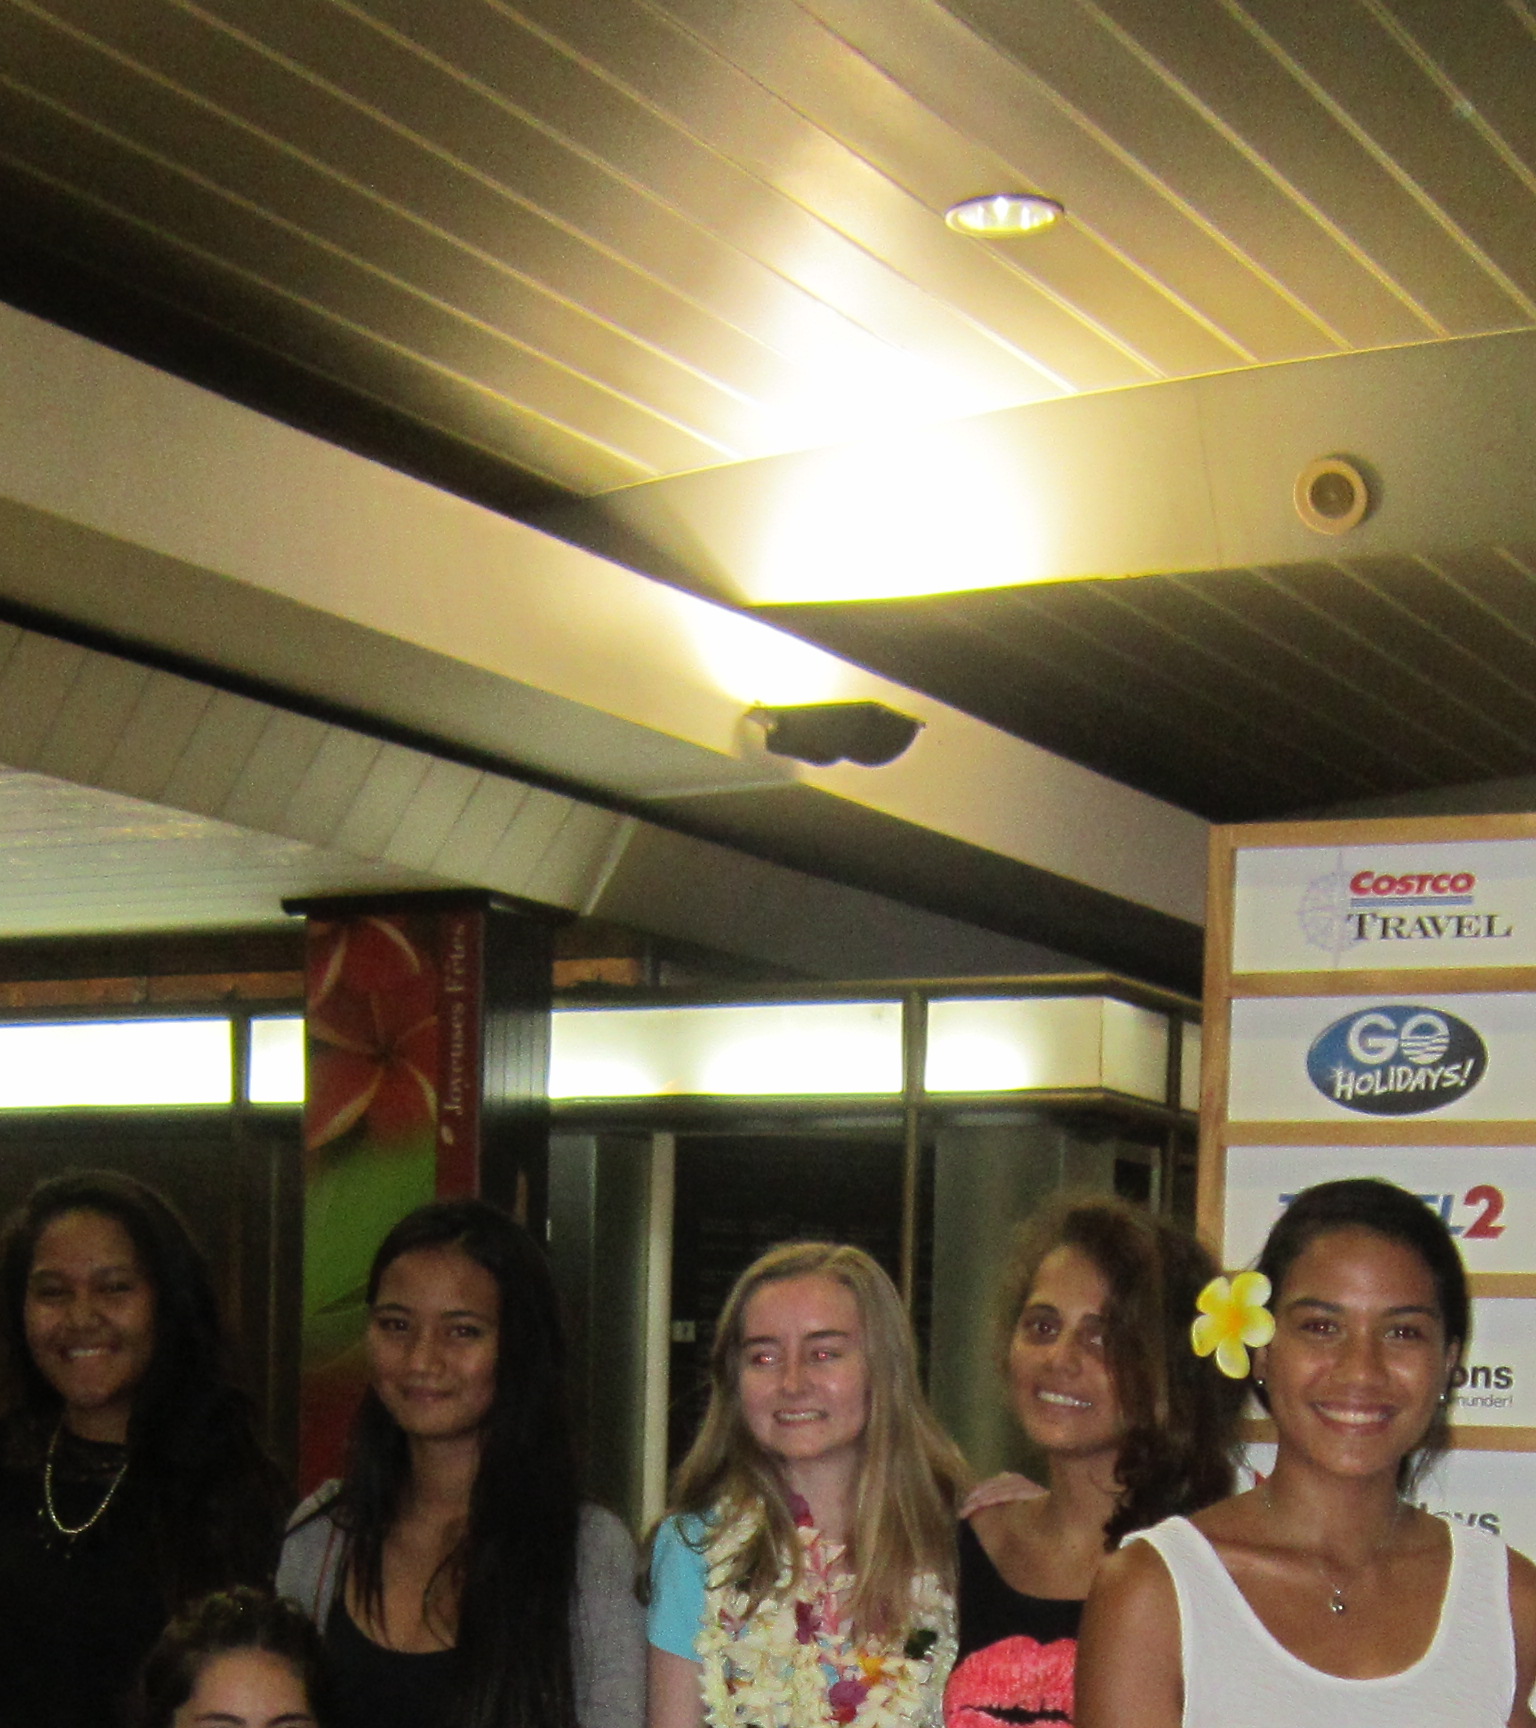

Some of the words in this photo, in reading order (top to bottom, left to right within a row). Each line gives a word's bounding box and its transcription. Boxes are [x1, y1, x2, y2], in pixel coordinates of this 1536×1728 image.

[1350, 870, 1475, 897] COSTCO
[1346, 911, 1512, 941] TRAVEL
[1347, 1012, 1450, 1064] GO
[1334, 1059, 1474, 1100] HOLIDAYS!
